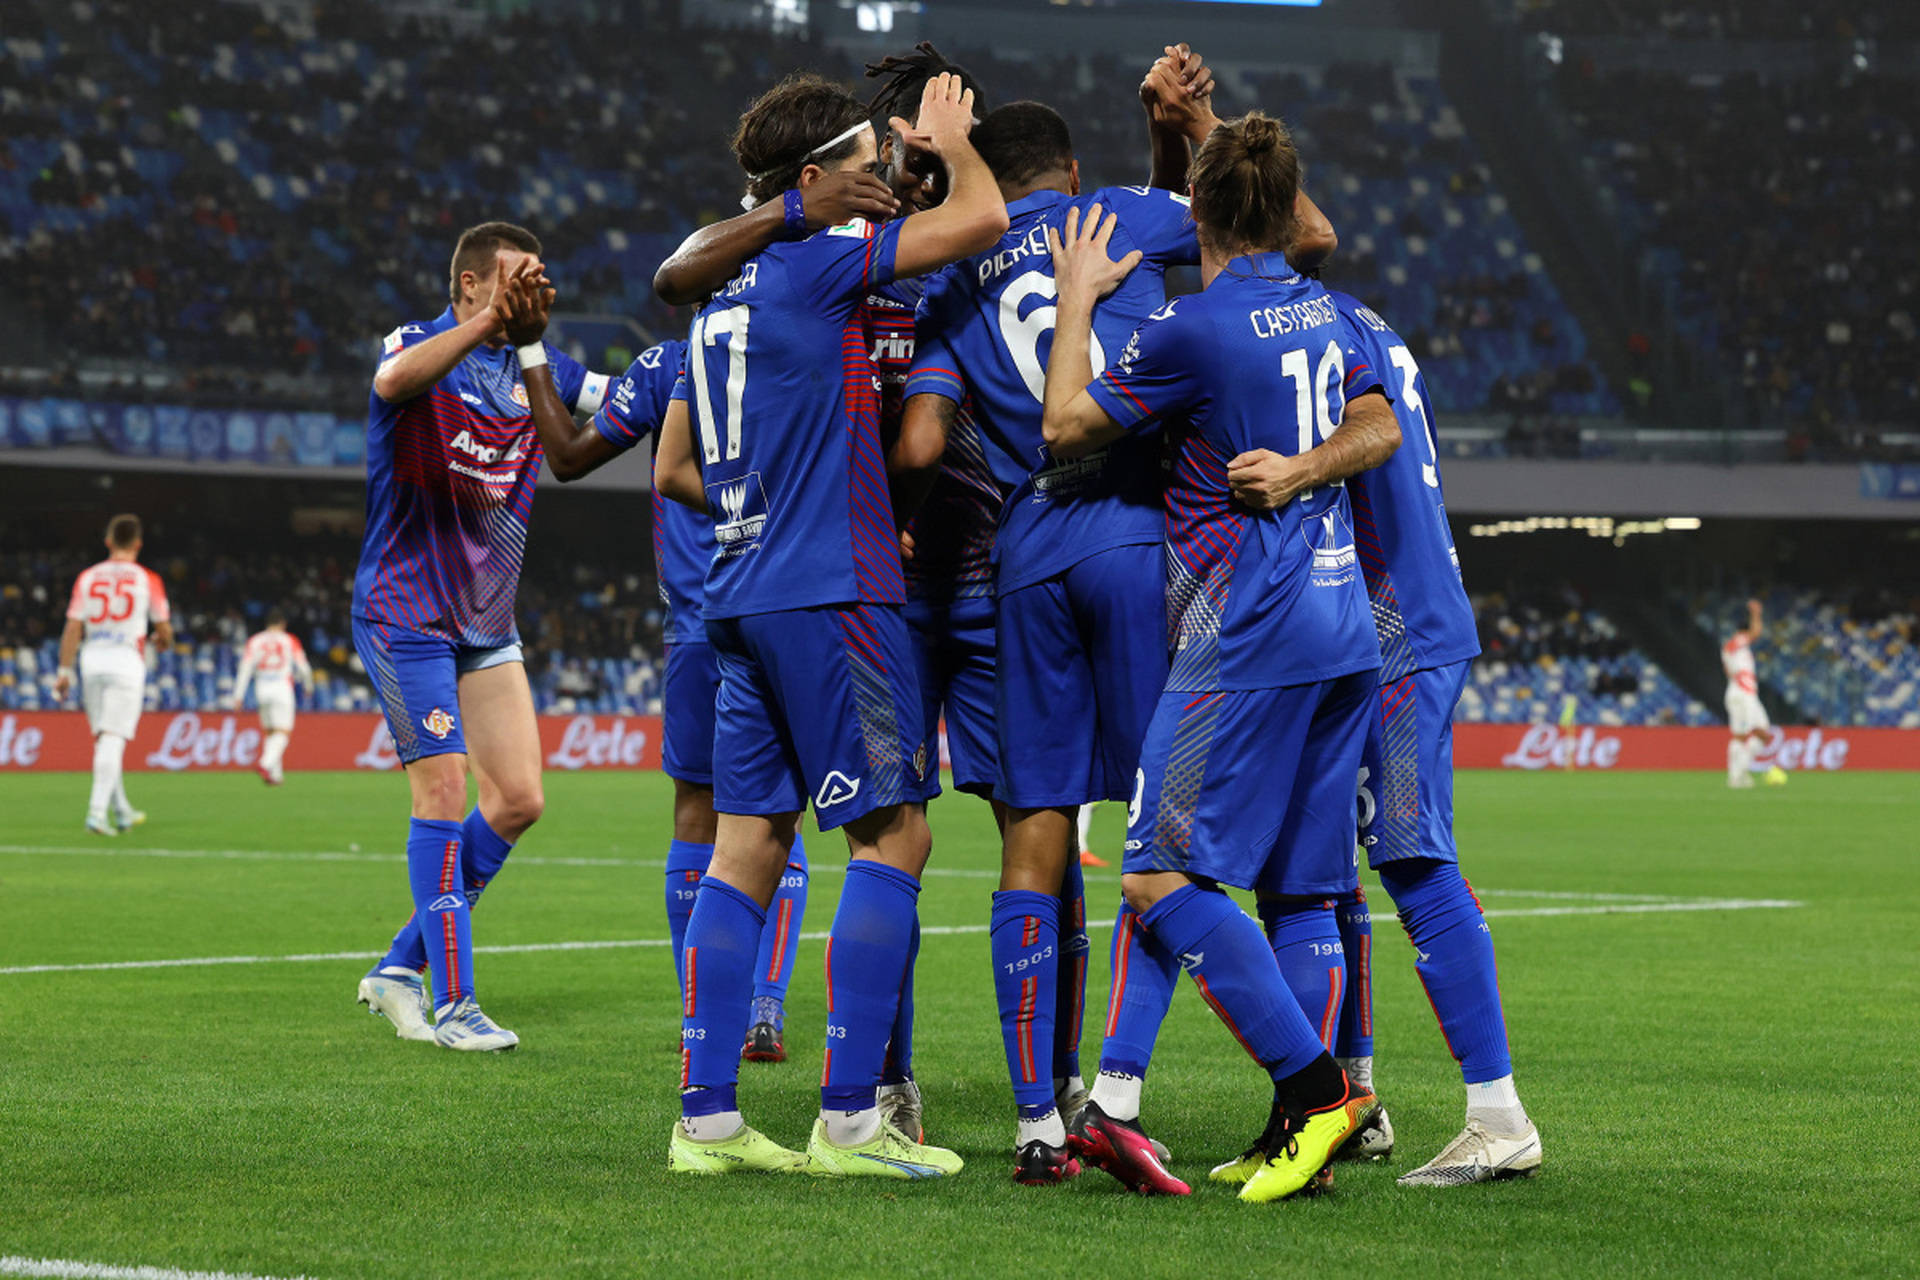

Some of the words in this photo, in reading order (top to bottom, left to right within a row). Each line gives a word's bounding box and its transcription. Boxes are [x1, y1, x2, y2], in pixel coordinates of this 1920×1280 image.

[999, 270, 1106, 404] 6
[691, 304, 750, 465] 17
[88, 579, 135, 624] 55
[0, 714, 43, 766] te
[146, 712, 261, 770] Lete
[547, 716, 646, 770] Lete
[1502, 723, 1622, 769] Lete
[779, 876, 804, 888] 903
[1004, 945, 1053, 975] 1903
[1309, 942, 1344, 956] 190
